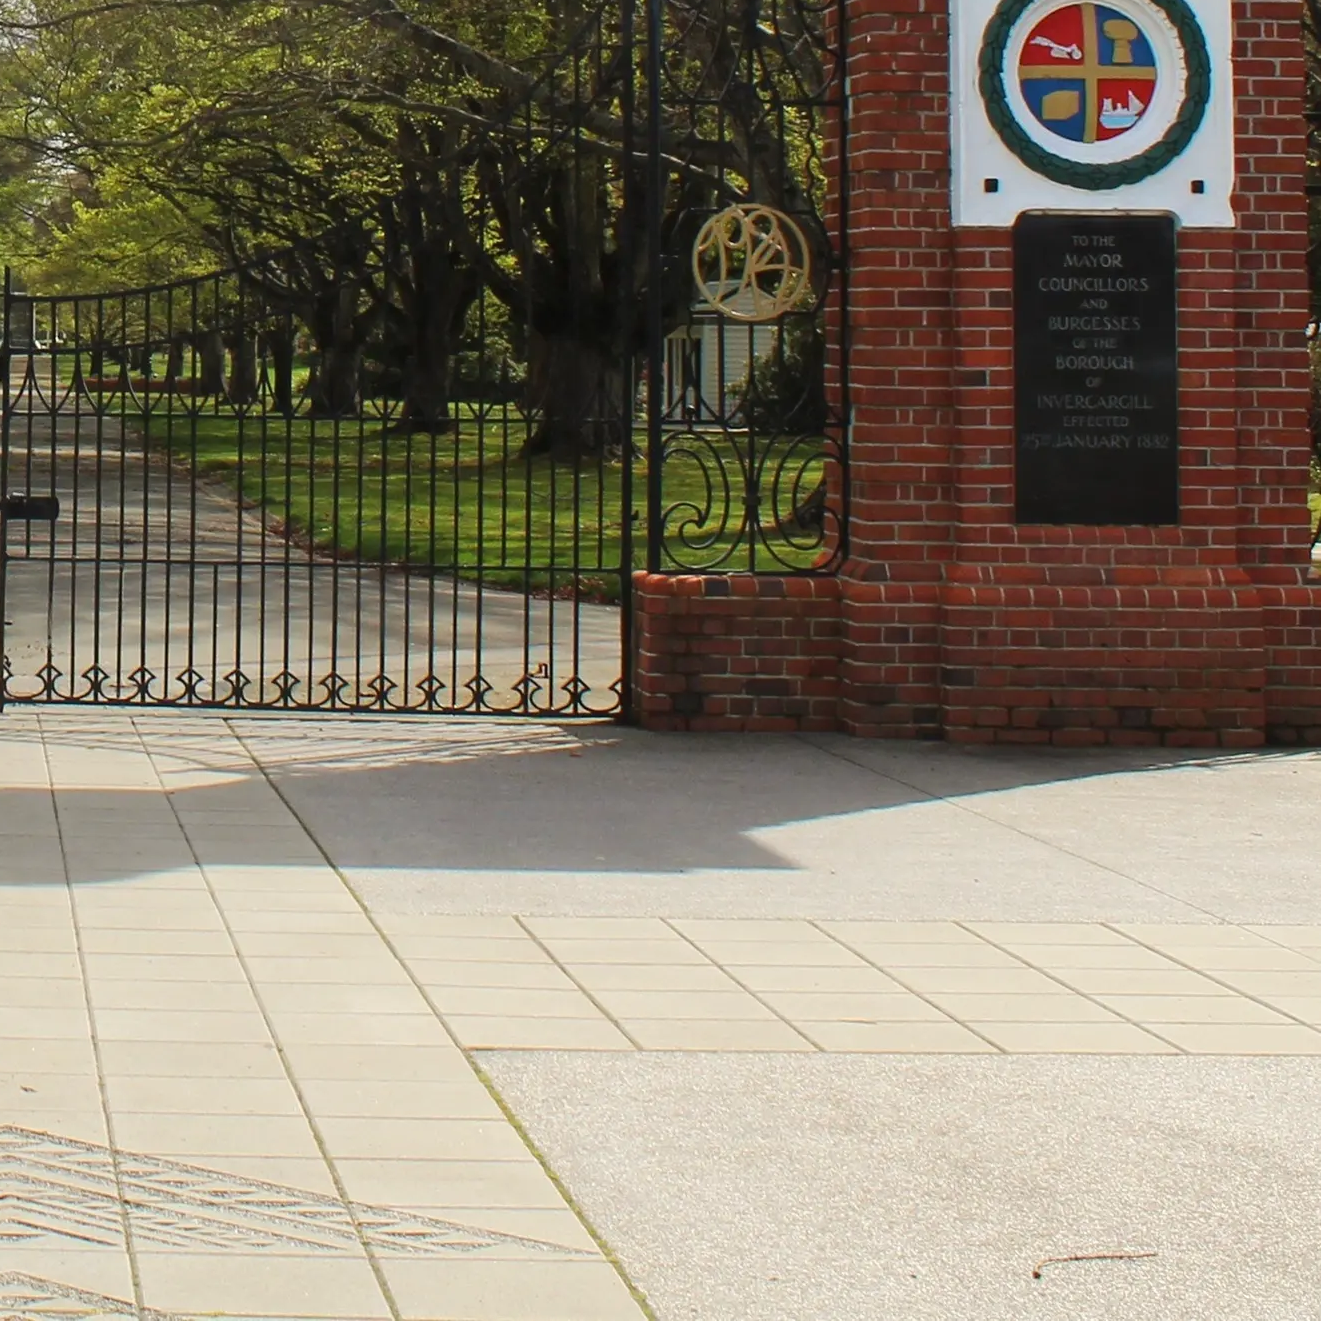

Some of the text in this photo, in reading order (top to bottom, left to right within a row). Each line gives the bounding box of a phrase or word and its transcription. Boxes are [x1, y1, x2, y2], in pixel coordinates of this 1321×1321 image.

[1071, 235, 1115, 247] TO THE
[1063, 253, 1123, 268] MAYOR
[1038, 277, 1149, 292] COUNCILLORS
[1078, 298, 1108, 310] AND
[1047, 316, 1141, 331] BURGESSES
[1093, 337, 1117, 349] THE
[1055, 355, 1134, 371] BOROUGH
[1037, 394, 1154, 410] INVERCARGILL
[1063, 416, 1129, 427] EFFECTED
[1052, 433, 1132, 449] JANUARY
